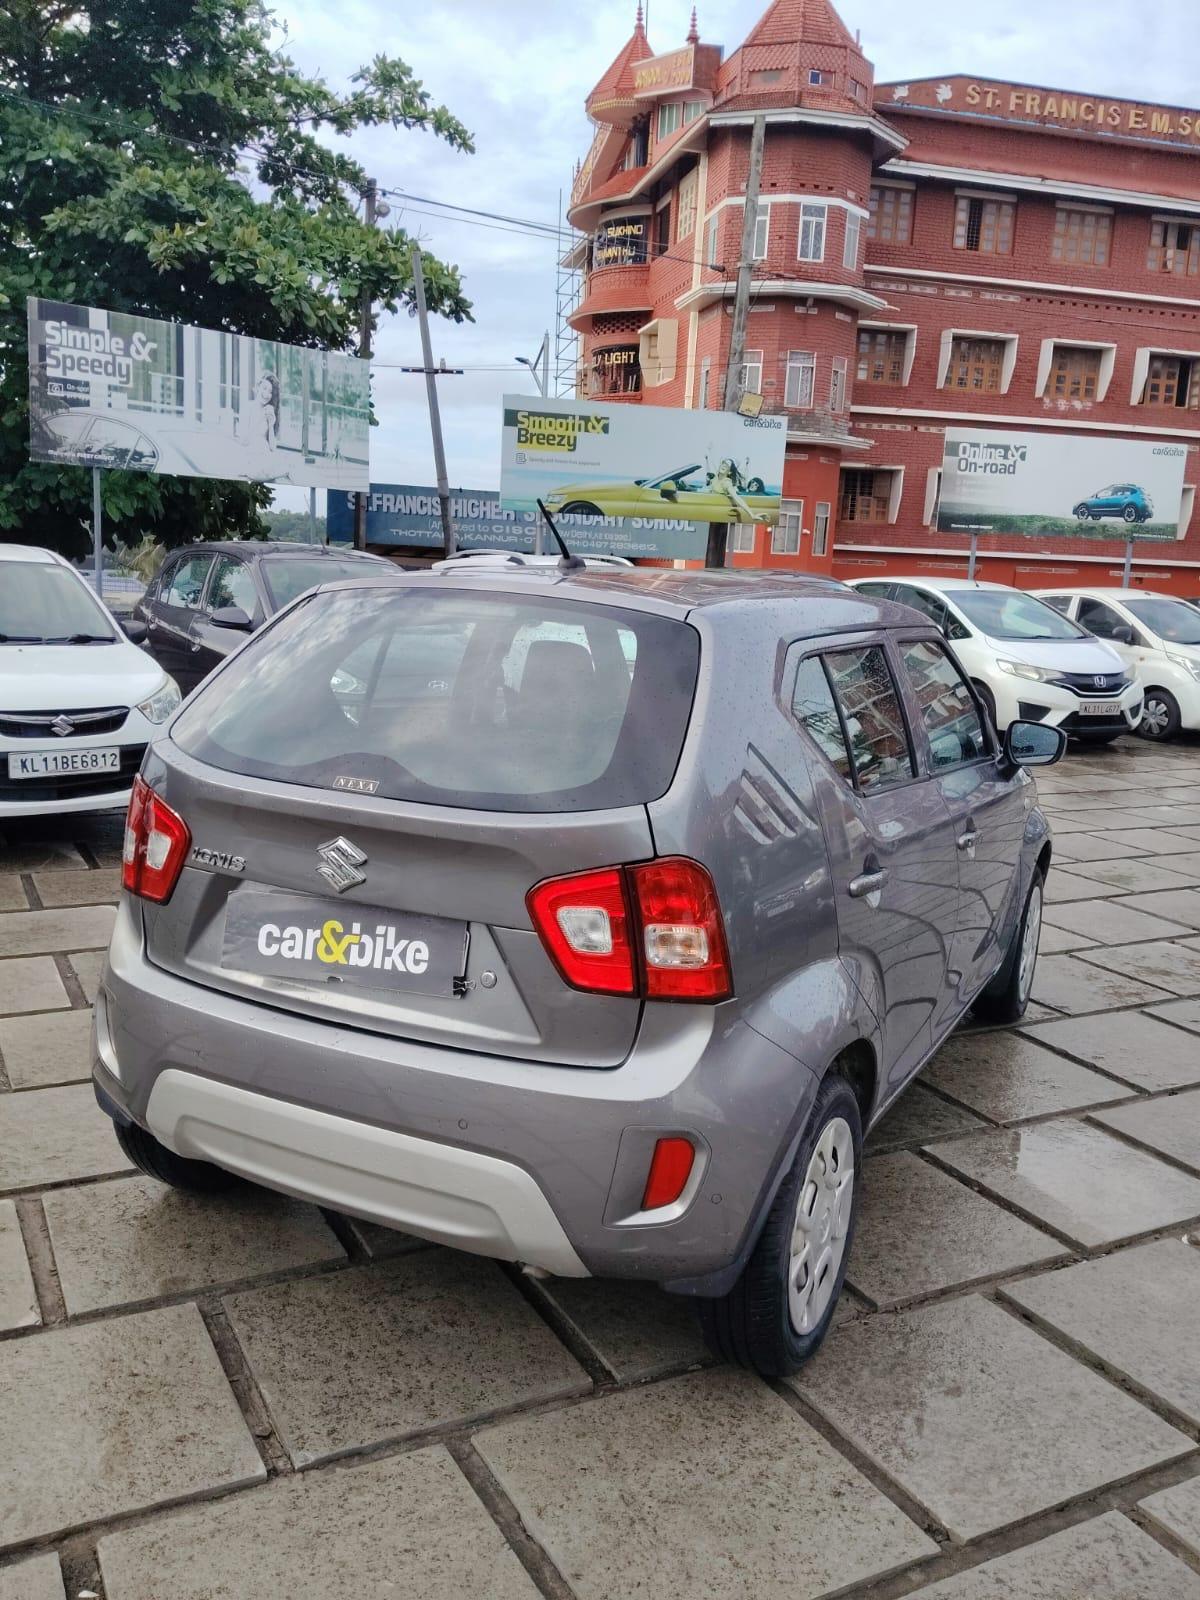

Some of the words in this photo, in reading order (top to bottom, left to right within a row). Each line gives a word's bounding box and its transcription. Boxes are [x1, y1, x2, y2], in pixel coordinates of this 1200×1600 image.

[966, 84, 1000, 109] ST.
[1009, 91, 1121, 127] FRANCIS
[45, 320, 124, 356] Simple
[130, 331, 157, 362] &
[47, 348, 132, 385] Speedy
[605, 352, 636, 365] LIGHT
[517, 411, 585, 432] Smooth
[743, 418, 782, 429] car&bike
[517, 427, 577, 452] Breezy
[958, 442, 1003, 460] Online
[1007, 444, 1027, 462] &
[957, 457, 1016, 475] On-road
[452, 498, 515, 521] HIGHER
[524, 511, 625, 529] SONDARY
[20, 752, 118, 773] KL11BE6812
[336, 777, 376, 792] NEXA
[191, 846, 247, 872] IGNIS
[257, 919, 429, 975] car&bike
